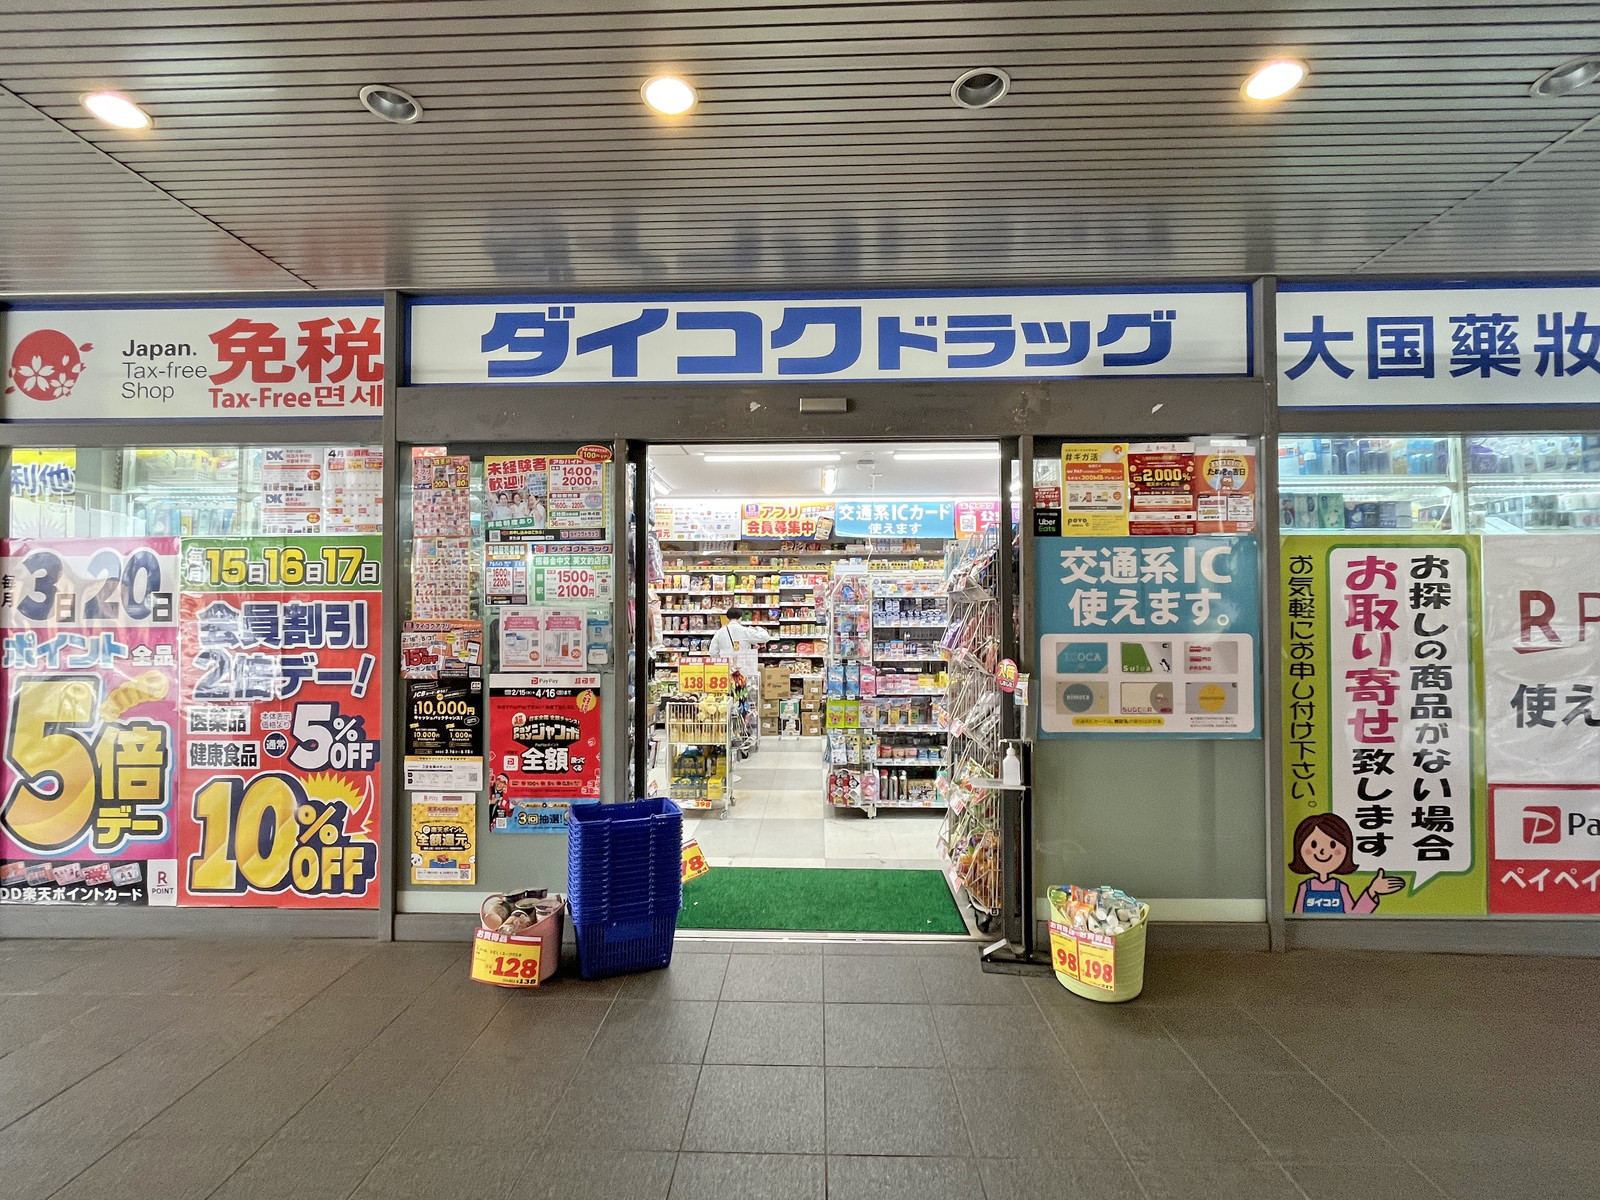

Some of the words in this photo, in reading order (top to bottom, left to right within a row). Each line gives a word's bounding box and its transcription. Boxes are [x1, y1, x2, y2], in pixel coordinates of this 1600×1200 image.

[122, 339, 198, 360] Japan.
[208, 317, 384, 385] 免税
[481, 306, 1177, 378] ダイコクドラッグ
[122, 361, 208, 379] Tax-free
[121, 382, 175, 402] Shop
[208, 387, 311, 408] Tax-Free
[314, 384, 382, 407] 면세
[488, 458, 546, 476] 未経験者
[563, 467, 597, 476] 1400円
[489, 475, 524, 491] 歓迎!
[562, 477, 597, 486] 2000円
[762, 506, 798, 518] アプリ
[839, 504, 951, 520] 交通系ICカード
[748, 521, 813, 534] 会員募集中
[868, 523, 922, 534] 使えます
[1060, 546, 1232, 584] 交通系IC
[557, 571, 595, 583] 1500円
[557, 585, 595, 597] 2100円
[1069, 588, 1229, 627] 使えます。
[1520, 590, 1562, 642] R
[197, 602, 367, 647] 会員割引
[3, 633, 128, 667] ポイント
[132, 645, 174, 666] 全品
[684, 677, 703, 688] 138
[709, 677, 728, 688] 88
[1289, 555, 1317, 808] お気軽にお申し付け下さい。
[417, 701, 475, 715] 10,000円
[1409, 555, 1454, 860] お探しの商品がない場合
[190, 708, 246, 732] 医薬品
[190, 743, 257, 766] 健康食品
[266, 740, 286, 750] 通常
[331, 743, 373, 769] OFF
[521, 748, 569, 772] 全額
[157, 871, 168, 886] R
[292, 847, 365, 891] OFF
[1306, 898, 1340, 906] ダイコク
[493, 957, 537, 978] 128
[1057, 949, 1077, 972] 98
[1085, 960, 1112, 983] 198
